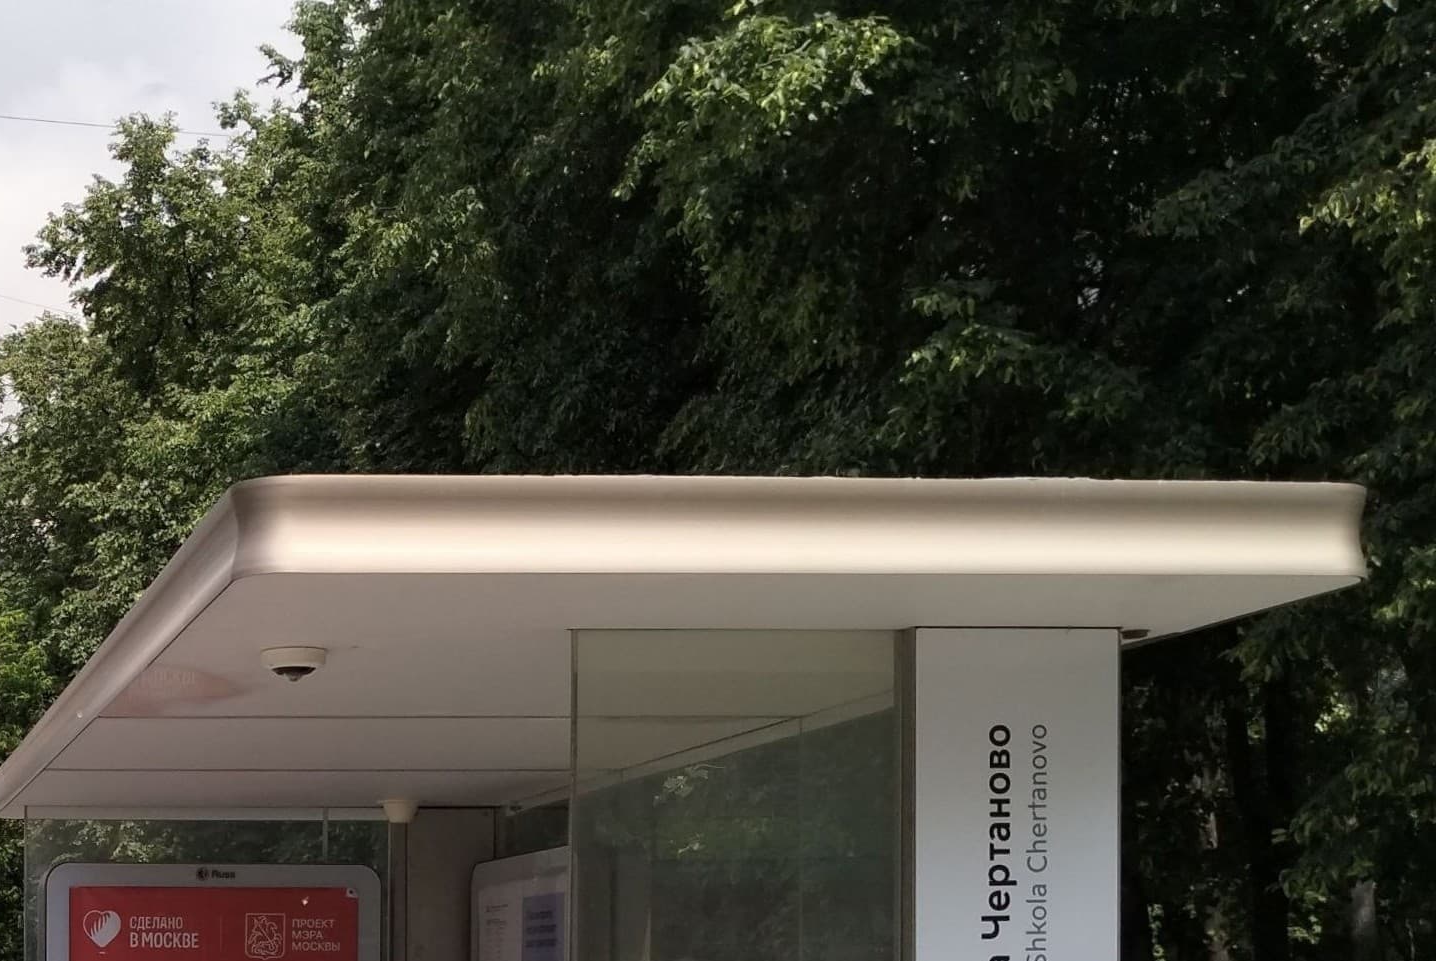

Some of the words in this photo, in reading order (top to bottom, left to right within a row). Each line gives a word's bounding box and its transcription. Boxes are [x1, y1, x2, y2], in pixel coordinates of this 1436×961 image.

[1026, 723, 1049, 874] Chertanovo
[980, 723, 1018, 940] Чертаново
[129, 915, 184, 931] СДЕЛАНО
[291, 918, 336, 929] ПРОЕКТ
[129, 932, 140, 949] В
[141, 933, 200, 949] МОСКВЕ
[291, 930, 324, 940] МЭРА
[291, 941, 341, 952] МОСКВЫ
